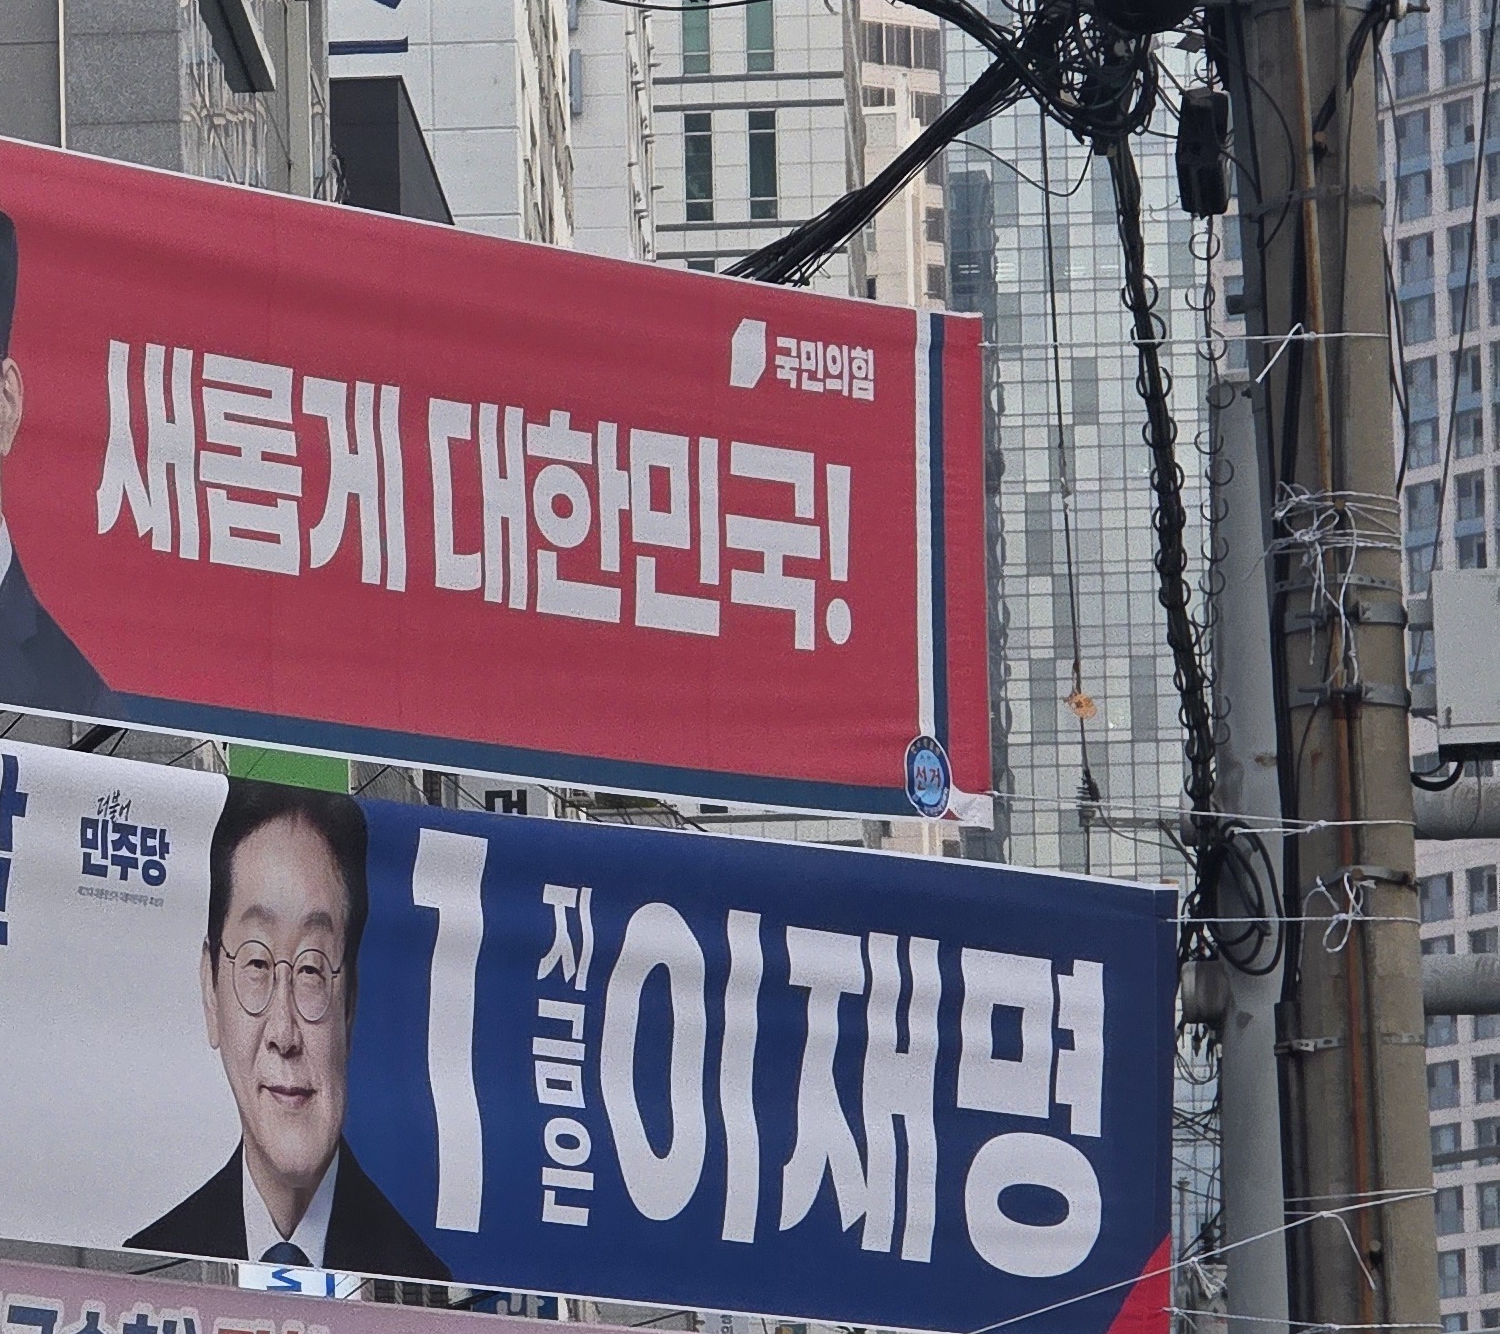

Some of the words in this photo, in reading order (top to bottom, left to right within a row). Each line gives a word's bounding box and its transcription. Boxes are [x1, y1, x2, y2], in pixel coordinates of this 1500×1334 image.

[97, 338, 407, 592] 새롭게
[428, 395, 854, 651] 대한민국!
[774, 333, 876, 403] 국민의힘
[80, 816, 171, 887] 민주당
[411, 827, 489, 1234] 1
[530, 883, 595, 1228] 지금은
[599, 899, 1105, 1279] 이재명
